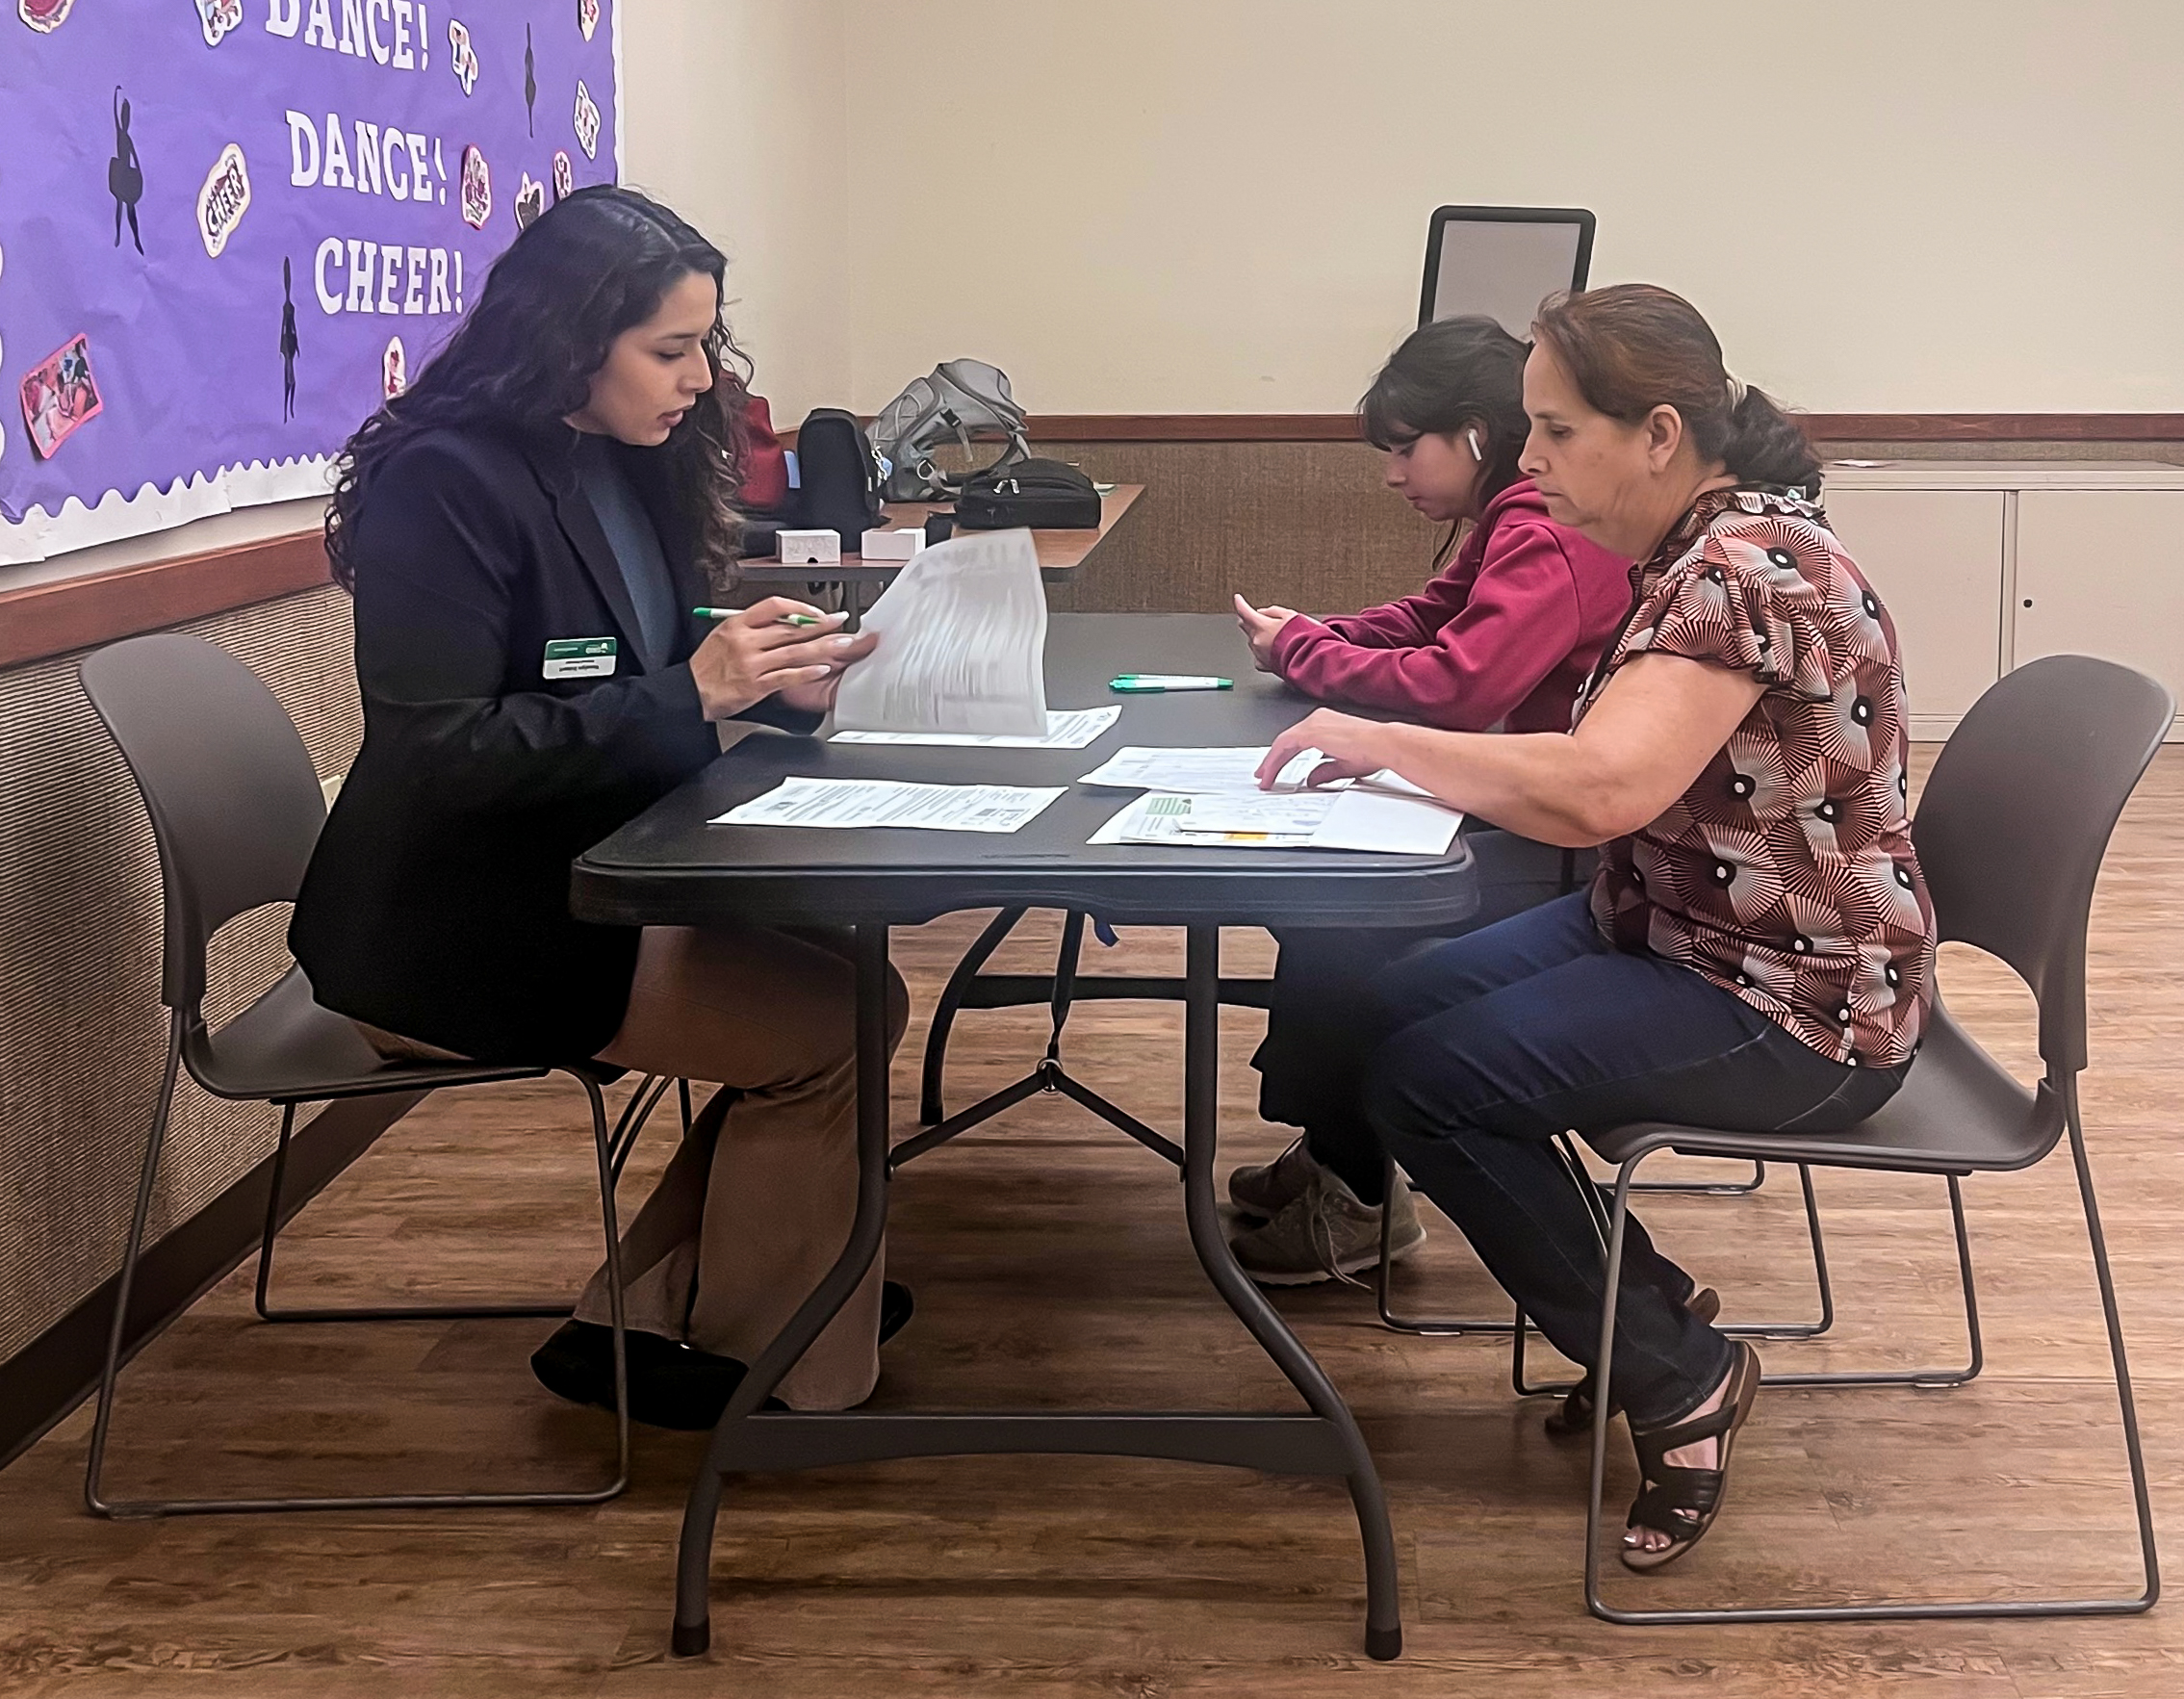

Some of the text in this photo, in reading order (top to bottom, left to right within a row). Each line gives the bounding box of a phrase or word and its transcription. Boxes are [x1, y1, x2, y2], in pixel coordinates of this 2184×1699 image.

[285, 109, 448, 206] DANCE!
[206, 165, 245, 237] CHEER
[314, 237, 463, 315] CHEER!
